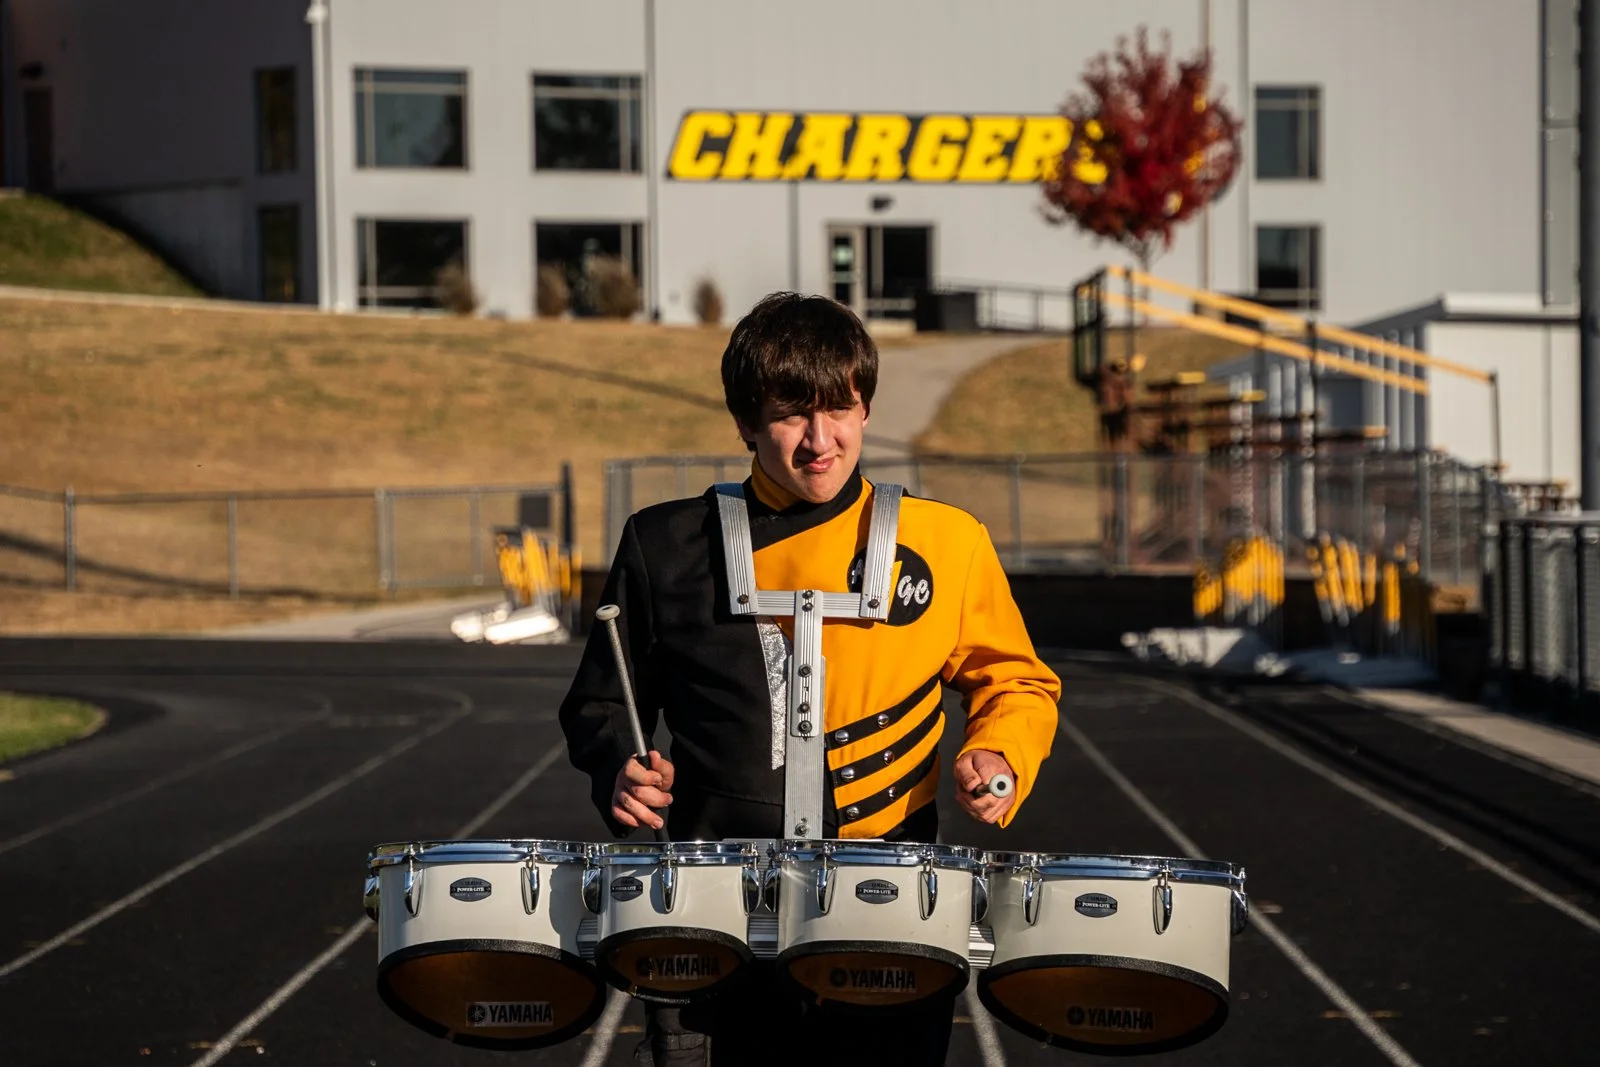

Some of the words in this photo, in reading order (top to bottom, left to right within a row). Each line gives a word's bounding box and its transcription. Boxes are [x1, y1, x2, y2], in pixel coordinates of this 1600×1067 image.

[656, 957, 720, 976] YAMAHA
[850, 969, 915, 988] YAMAHA
[488, 1005, 553, 1023] YAMAHA
[1088, 1008, 1154, 1030] YAMAHA
